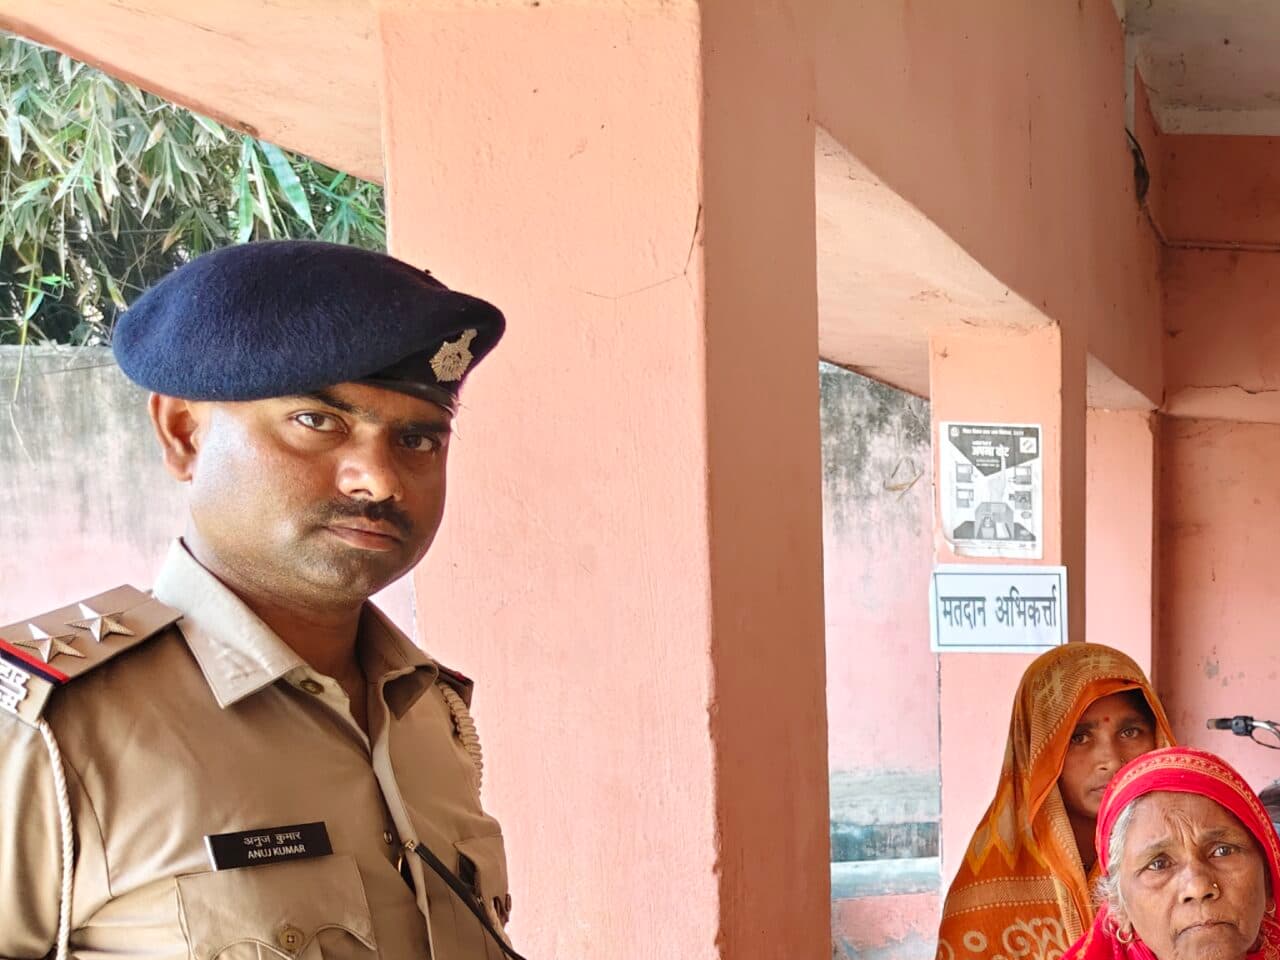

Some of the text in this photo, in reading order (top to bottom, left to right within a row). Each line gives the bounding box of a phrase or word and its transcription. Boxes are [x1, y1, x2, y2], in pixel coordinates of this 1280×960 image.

[940, 595, 986, 629] मतदान
[243, 831, 301, 847] अनुज कुमार
[248, 844, 306, 860] ANUJ KUMAR
